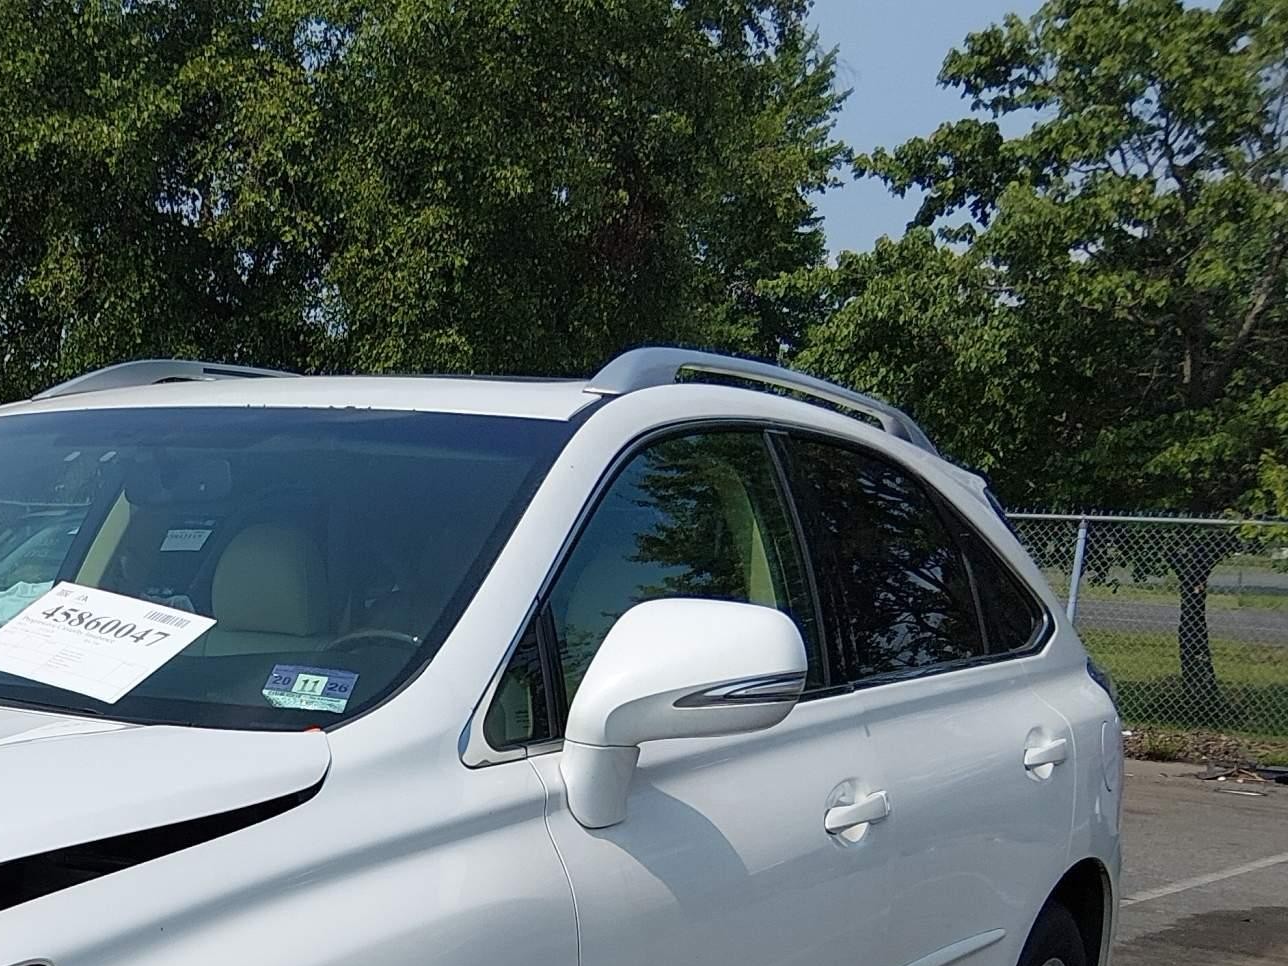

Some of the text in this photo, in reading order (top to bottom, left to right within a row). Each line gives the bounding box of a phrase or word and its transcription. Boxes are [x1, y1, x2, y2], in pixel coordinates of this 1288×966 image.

[42, 605, 171, 647] 45860047
[272, 675, 348, 693] 20 11 26
